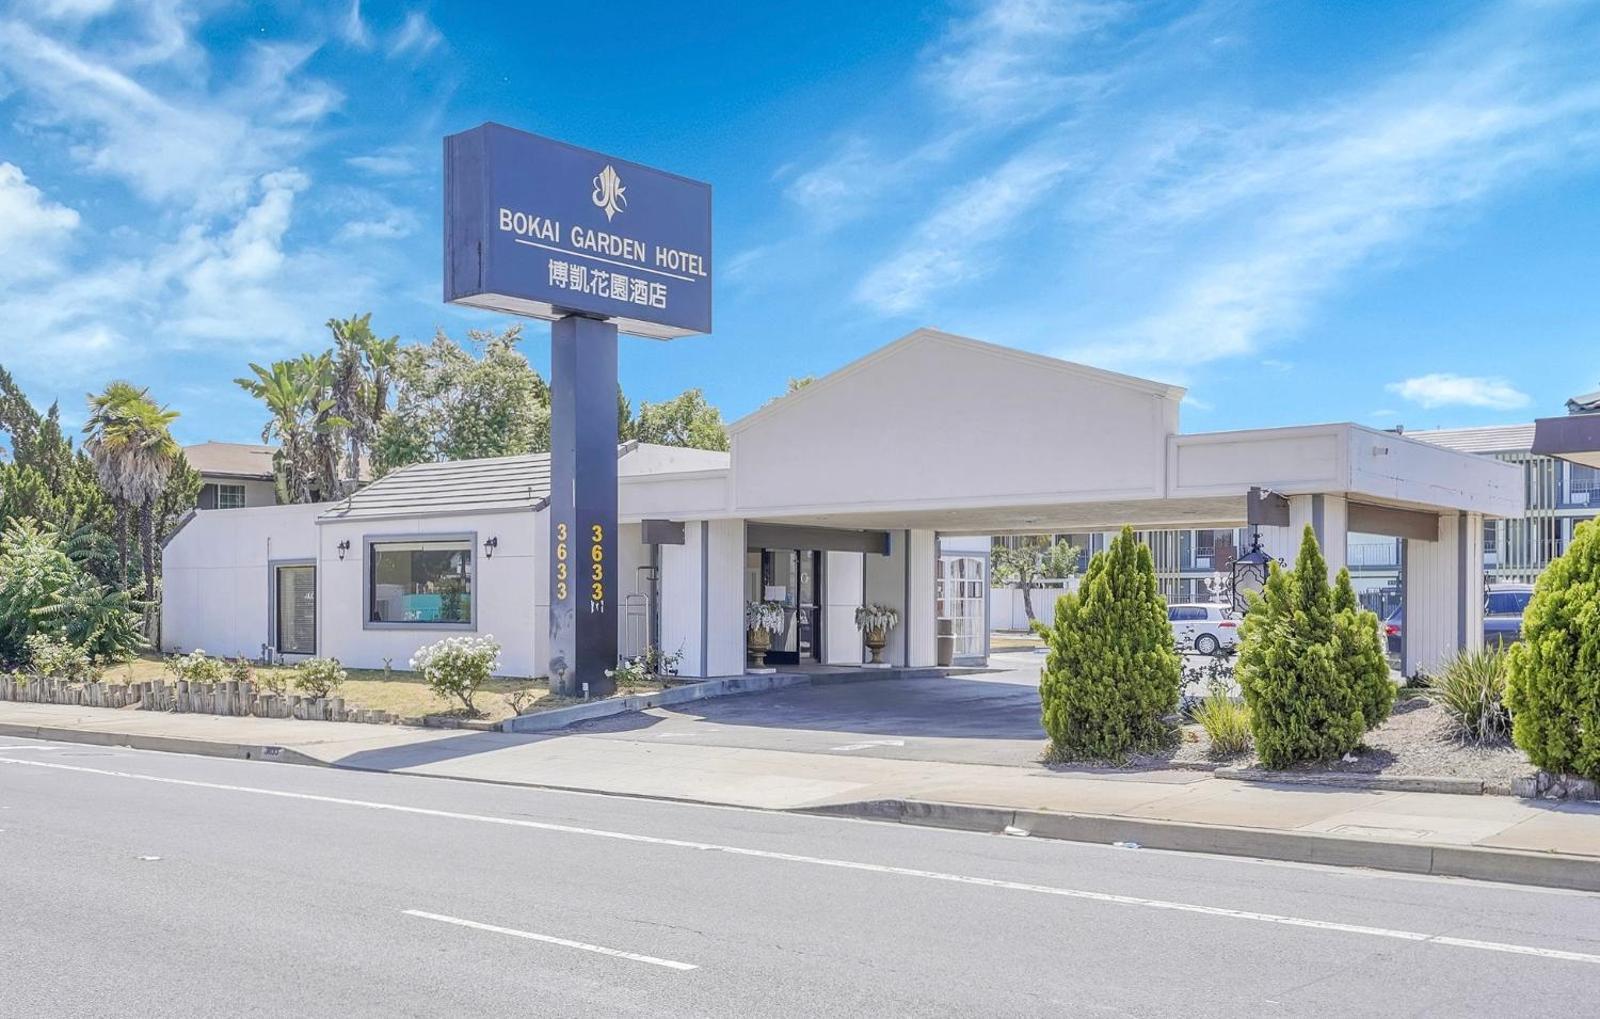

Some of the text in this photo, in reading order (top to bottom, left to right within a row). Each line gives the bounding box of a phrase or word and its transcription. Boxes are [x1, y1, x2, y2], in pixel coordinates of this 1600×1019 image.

[499, 208, 708, 277] BOKAI GARDEN HOTEL
[548, 259, 667, 309] 博凱花園酒店
[557, 523, 567, 600] 3633
[591, 525, 603, 600] 3633
